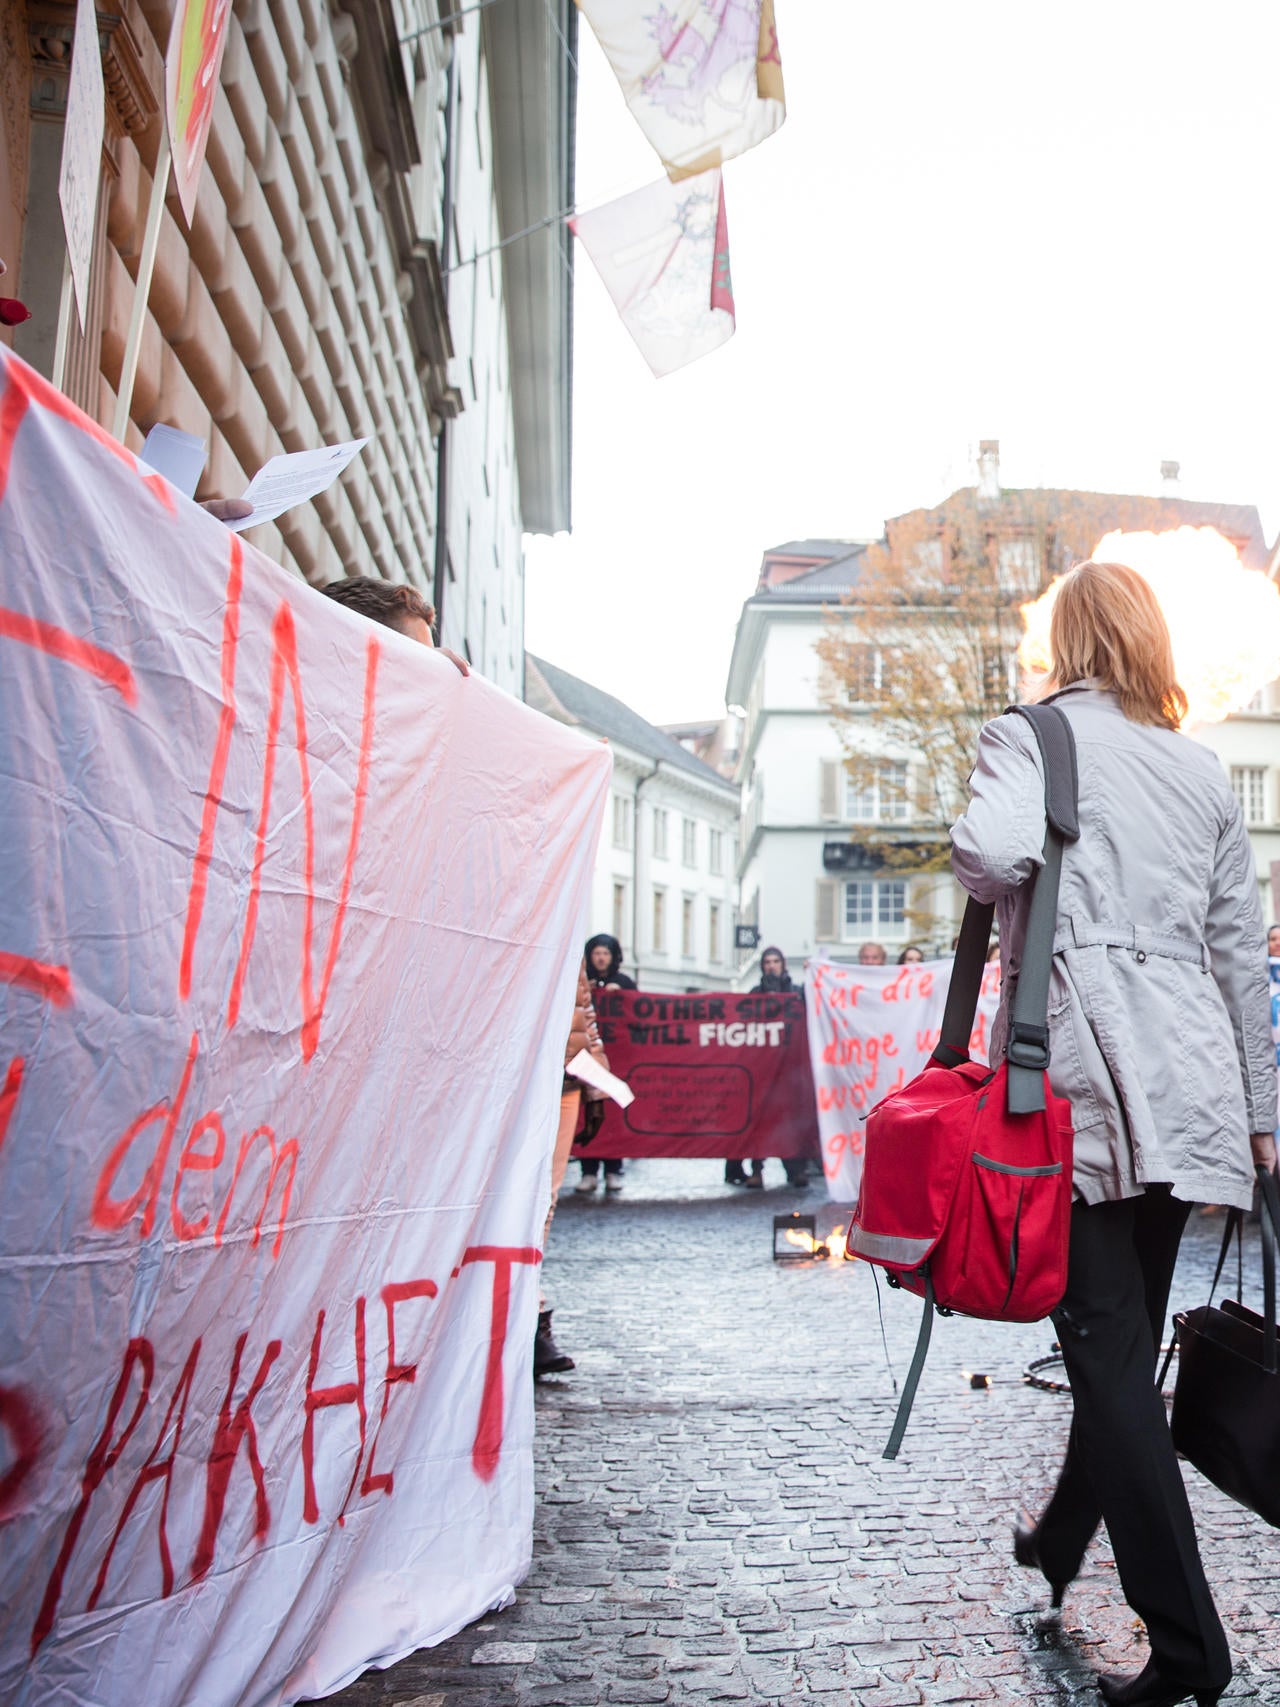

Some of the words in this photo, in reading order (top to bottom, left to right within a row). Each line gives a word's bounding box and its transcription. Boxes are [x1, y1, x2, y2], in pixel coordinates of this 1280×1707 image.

[633, 996, 725, 1019] OTHER
[736, 998, 801, 1020] SIDE
[814, 966, 864, 1014] für
[881, 966, 934, 1002] die
[627, 1022, 691, 1045] WILL
[699, 1020, 793, 1047] FIGHT!
[92, 1030, 300, 1260] dem
